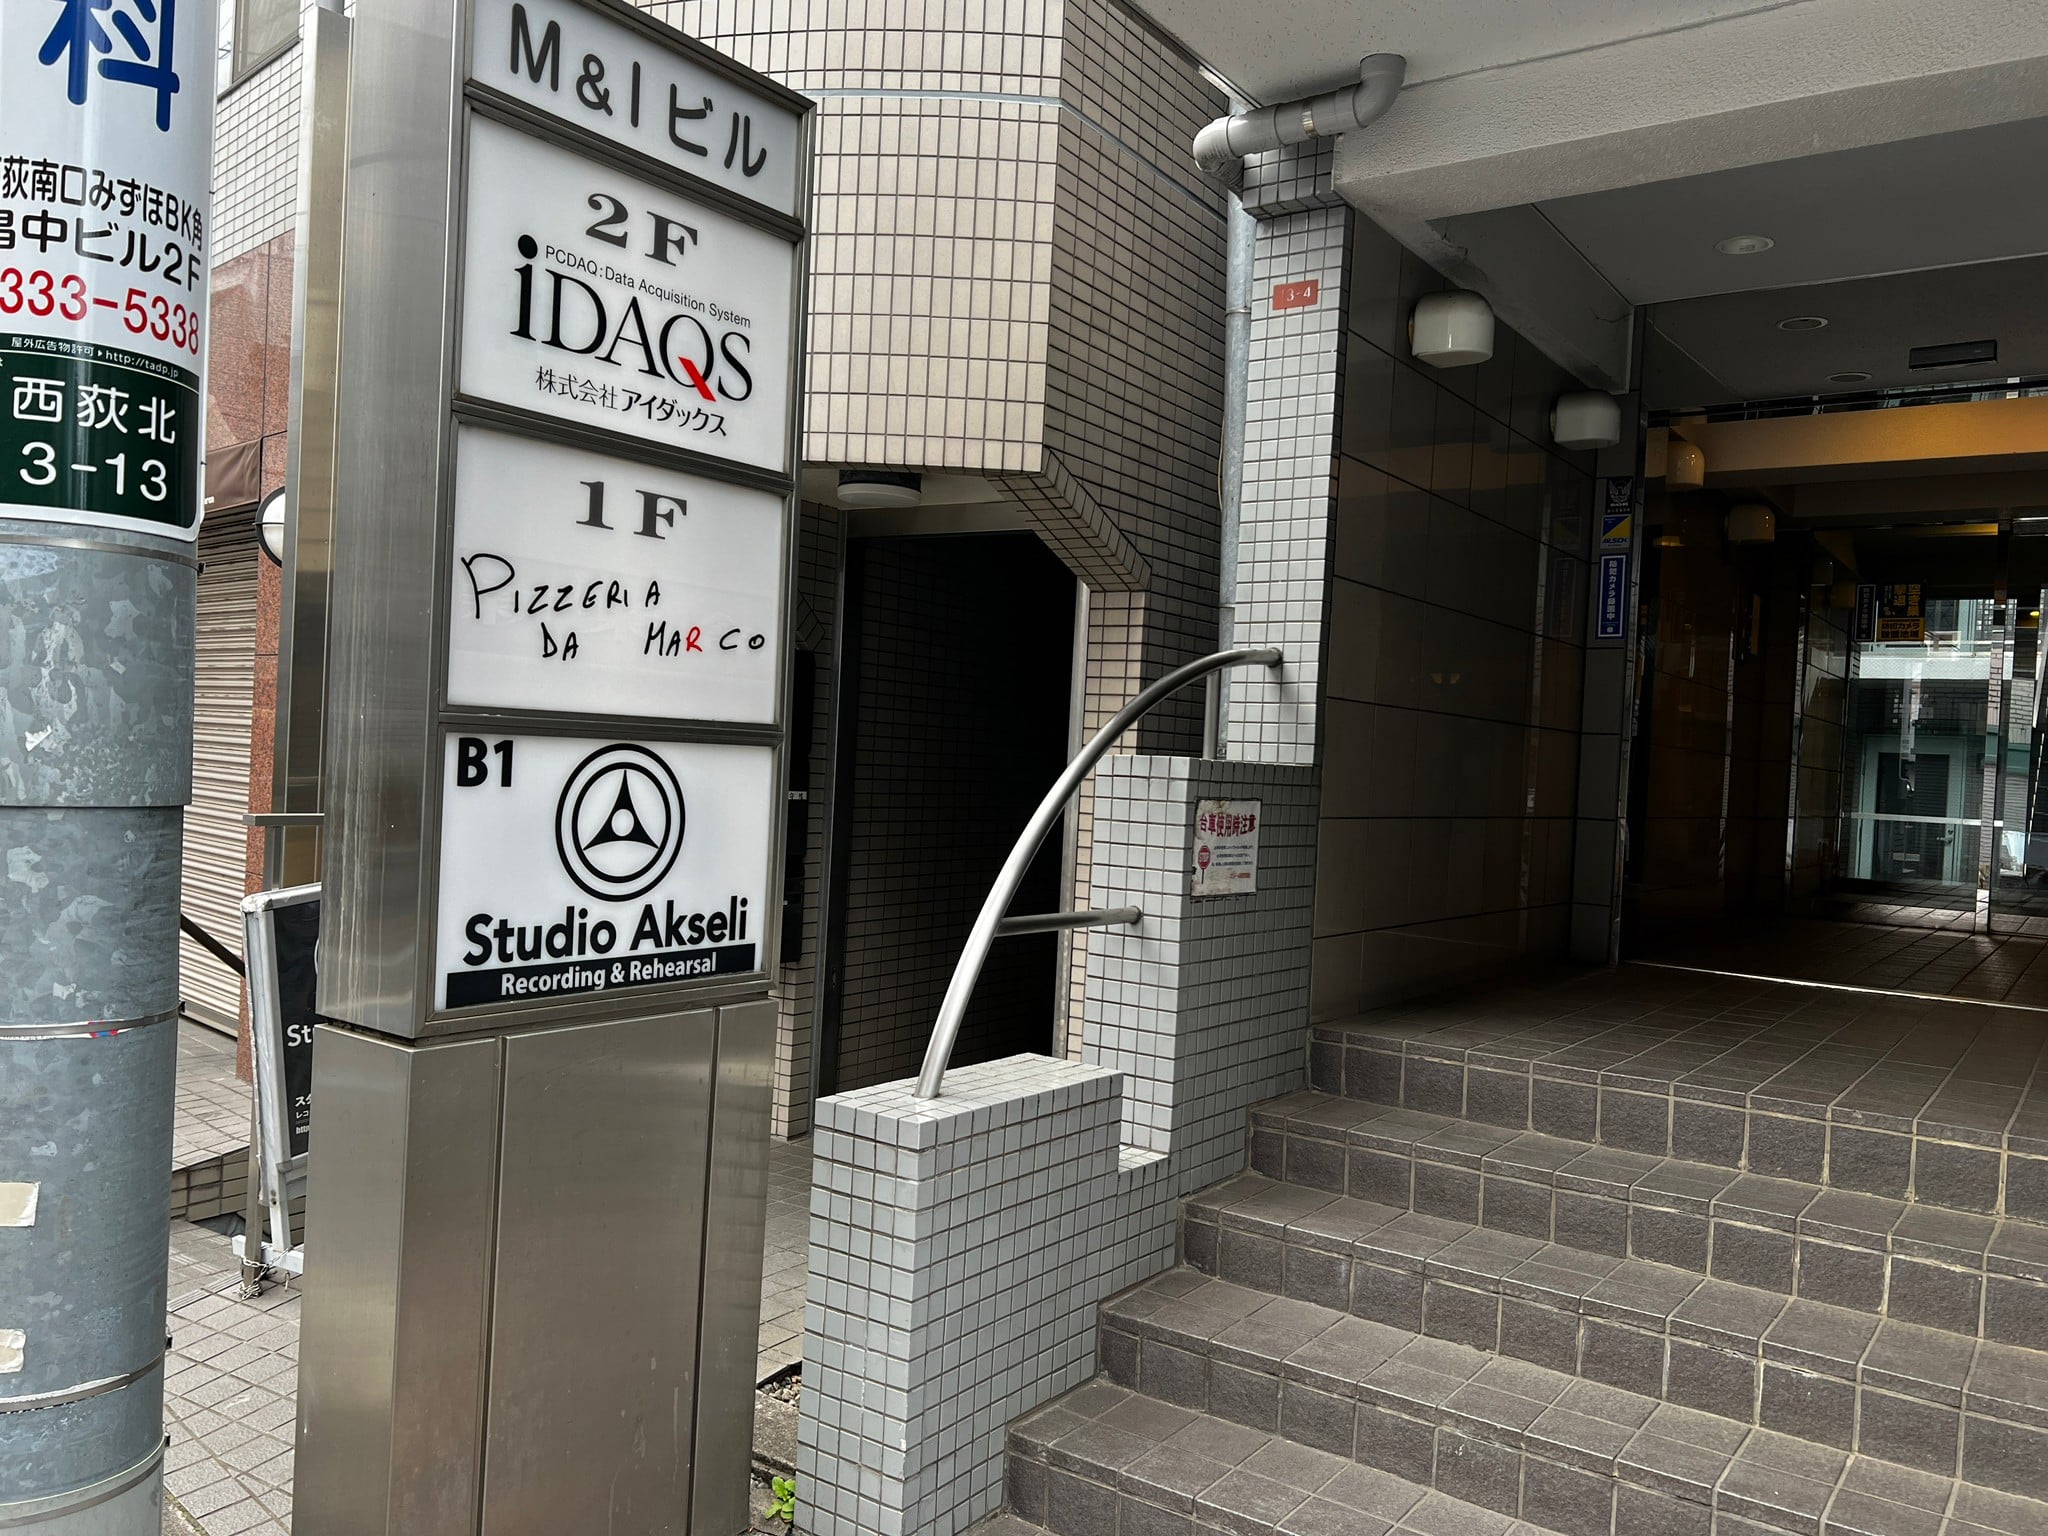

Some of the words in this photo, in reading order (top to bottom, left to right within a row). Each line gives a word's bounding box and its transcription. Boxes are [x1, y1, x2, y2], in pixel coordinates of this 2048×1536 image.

[0, 155, 203, 252] 荻南口みずほBK角
[638, 277, 706, 314] Acquisition
[708, 301, 752, 329] System
[11, 336, 95, 358] 屋外広告物許可
[12, 376, 176, 446] 西荻北
[19, 441, 168, 503] 3-13
[542, 621, 580, 661] DA
[644, 621, 766, 657] MARCO
[456, 736, 514, 788] B1
[463, 906, 617, 967] Studio
[629, 894, 749, 951] Akseli
[500, 965, 607, 996] Recording
[609, 966, 625, 984] &
[628, 951, 718, 982] Rehearsal
[287, 1024, 314, 1047] St
